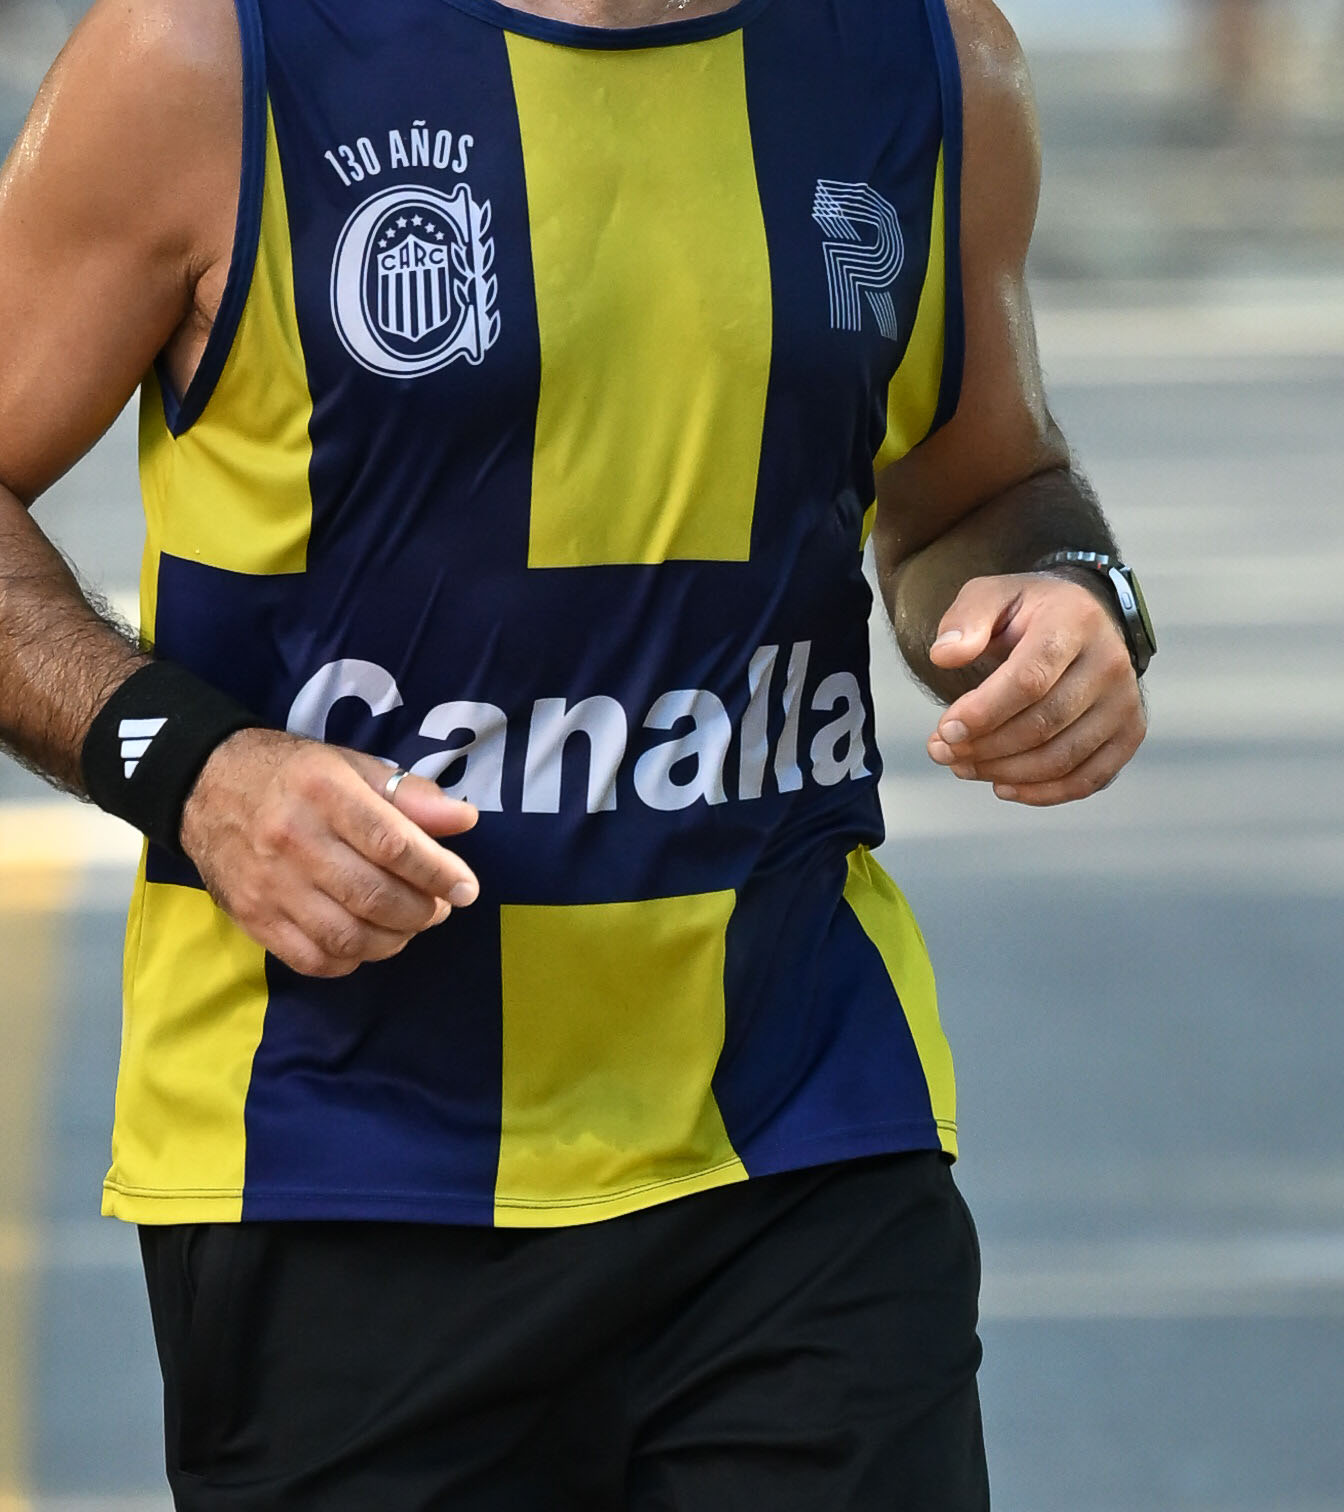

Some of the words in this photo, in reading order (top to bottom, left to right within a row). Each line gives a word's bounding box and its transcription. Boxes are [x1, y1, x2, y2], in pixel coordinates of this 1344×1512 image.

[324, 137, 381, 186] 130
[389, 120, 474, 174] AÑOS
[381, 240, 444, 271] CARC
